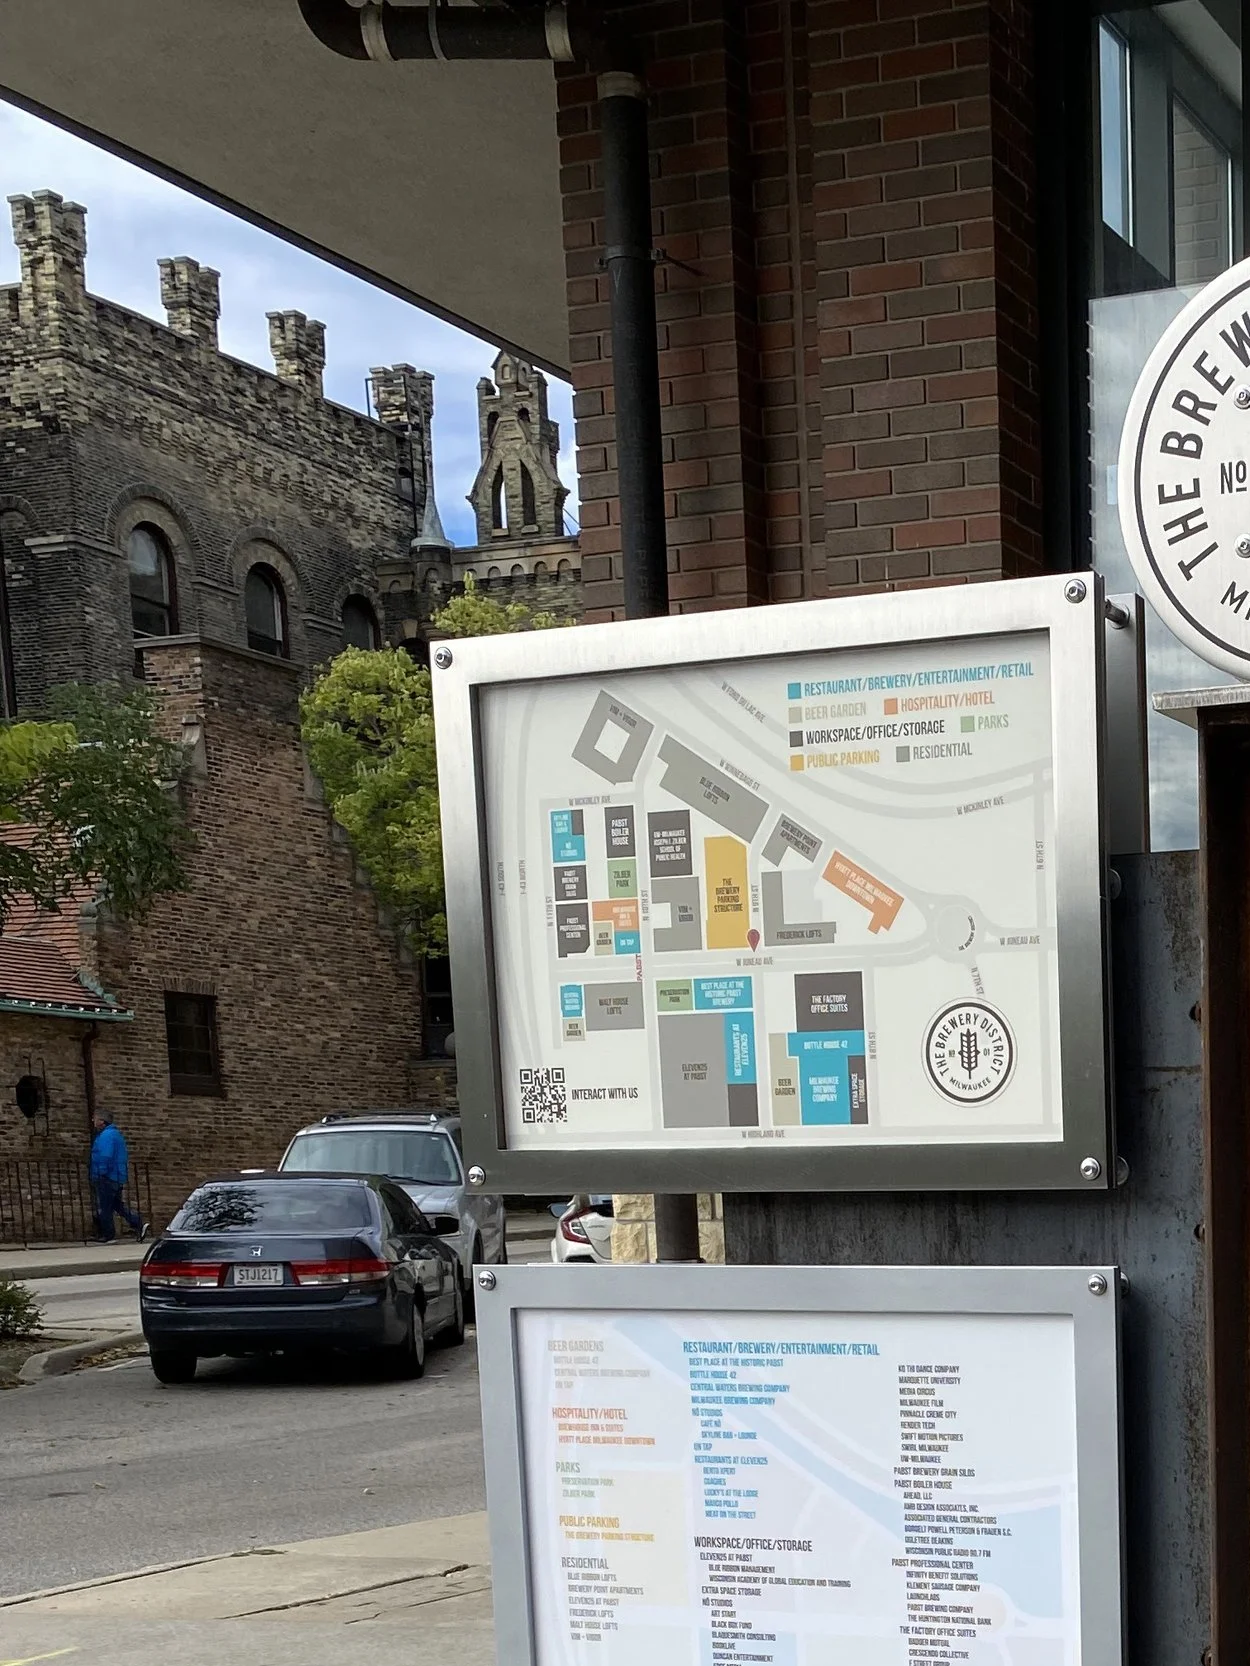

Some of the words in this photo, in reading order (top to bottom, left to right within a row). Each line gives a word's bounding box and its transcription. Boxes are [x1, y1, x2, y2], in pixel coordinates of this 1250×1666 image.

[1158, 477, 1219, 581] THE
[805, 662, 1033, 696] RESTAURANT/BREWERY/ENTERTAINMENT/RETAIL
[901, 691, 995, 712] HOSPITALITY/HOTEL
[805, 706, 828, 720] BEER
[831, 702, 866, 717] GARDEN
[978, 714, 1009, 730] PARKS
[806, 720, 945, 744] WORKSPACE/OFFICE/STORAGE
[913, 742, 972, 759] RESIDENTIAL
[807, 754, 838, 768] PUBLIC
[841, 750, 880, 765] PARKING
[612, 819, 627, 827] PABST
[612, 827, 629, 836] BOILER
[612, 837, 629, 845] HOUSE
[616, 879, 629, 888] PARK
[714, 904, 743, 912] STRUCTURE
[777, 931, 805, 939] FREDERICK
[1029, 935, 1040, 944] AVE
[701, 982, 712, 990] BEST
[823, 995, 846, 1003] FACTORY
[811, 1005, 828, 1013] OFFICE
[830, 1004, 848, 1012] SUITES
[935, 1013, 979, 1049] BREWERY
[804, 1041, 822, 1049] BOTTLE
[823, 1041, 840, 1049] HOUSE
[842, 1040, 847, 1048] 42
[980, 1018, 1004, 1074] DISTRICT
[935, 1053, 949, 1076] THE
[778, 1079, 791, 1087] BEER
[950, 1077, 991, 1090] MILWAUKEE
[572, 1088, 606, 1100] INTERACT
[608, 1088, 627, 1099] WITH
[629, 1088, 638, 1098] US
[775, 1087, 795, 1096] GARDEN
[813, 1094, 837, 1102] COMPANY
[548, 1341, 567, 1351] BEER
[569, 1341, 604, 1352] GARDENS
[683, 1342, 880, 1355] RESTAURANT/BREWERY/ENTERTAINMENT/RETAIL
[704, 1358, 720, 1366] PLACE
[741, 1359, 765, 1367] HISTORIC
[766, 1359, 783, 1367] PABST
[899, 1376, 929, 1384] MARQUETTE
[552, 1407, 627, 1420] HOSPITALITY/HOTEL
[556, 1461, 580, 1473] PARKS
[894, 1467, 911, 1475] PABST
[913, 1468, 939, 1476] BREWERY
[941, 1468, 958, 1476] GRAIN
[959, 1469, 975, 1477] SILOS
[913, 1480, 932, 1488] BOILER
[934, 1481, 952, 1489] HOUSE
[559, 1516, 585, 1527] PUBLIC
[587, 1516, 619, 1528] PARKING
[694, 1537, 812, 1551] WORKSPACE/OFFICE/STORAGE
[700, 1553, 727, 1561] ELEVEN25
[736, 1554, 752, 1562] PABST
[561, 1557, 609, 1569] RESIDENTIAL
[910, 1560, 950, 1568] PROFESSIONAL
[952, 1561, 973, 1569] CENTER
[738, 1588, 761, 1596] STORAGE
[900, 1626, 910, 1634] THE
[912, 1627, 936, 1635] FACTORY
[937, 1628, 955, 1636] OFFICE
[957, 1629, 976, 1637] SUITES
